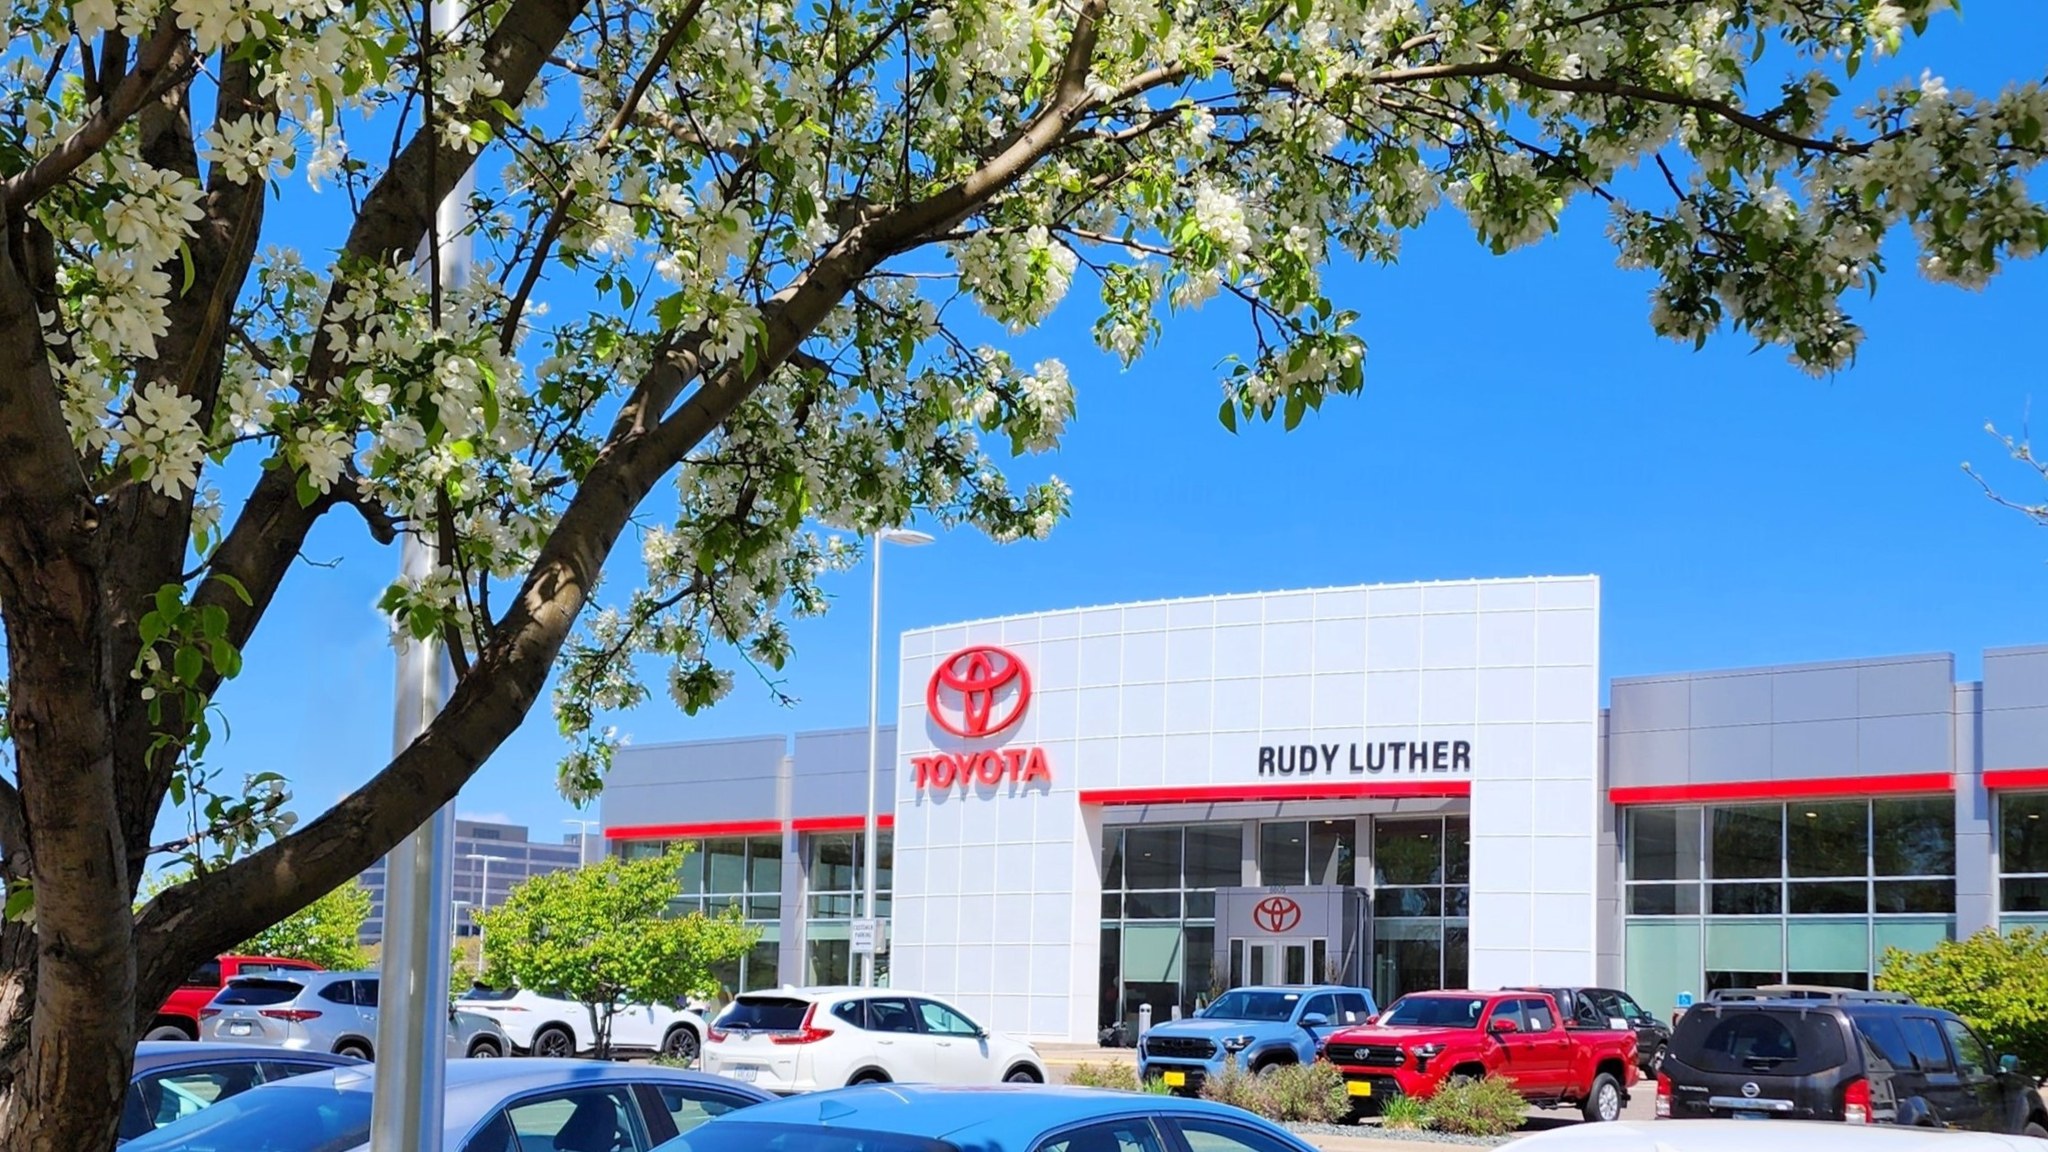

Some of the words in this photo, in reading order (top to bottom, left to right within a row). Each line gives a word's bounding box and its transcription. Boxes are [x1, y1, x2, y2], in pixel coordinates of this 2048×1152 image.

[911, 747, 1052, 789] TOYOTA
[1259, 744, 1340, 775] RUDY
[1350, 741, 1471, 774] LUTHER
